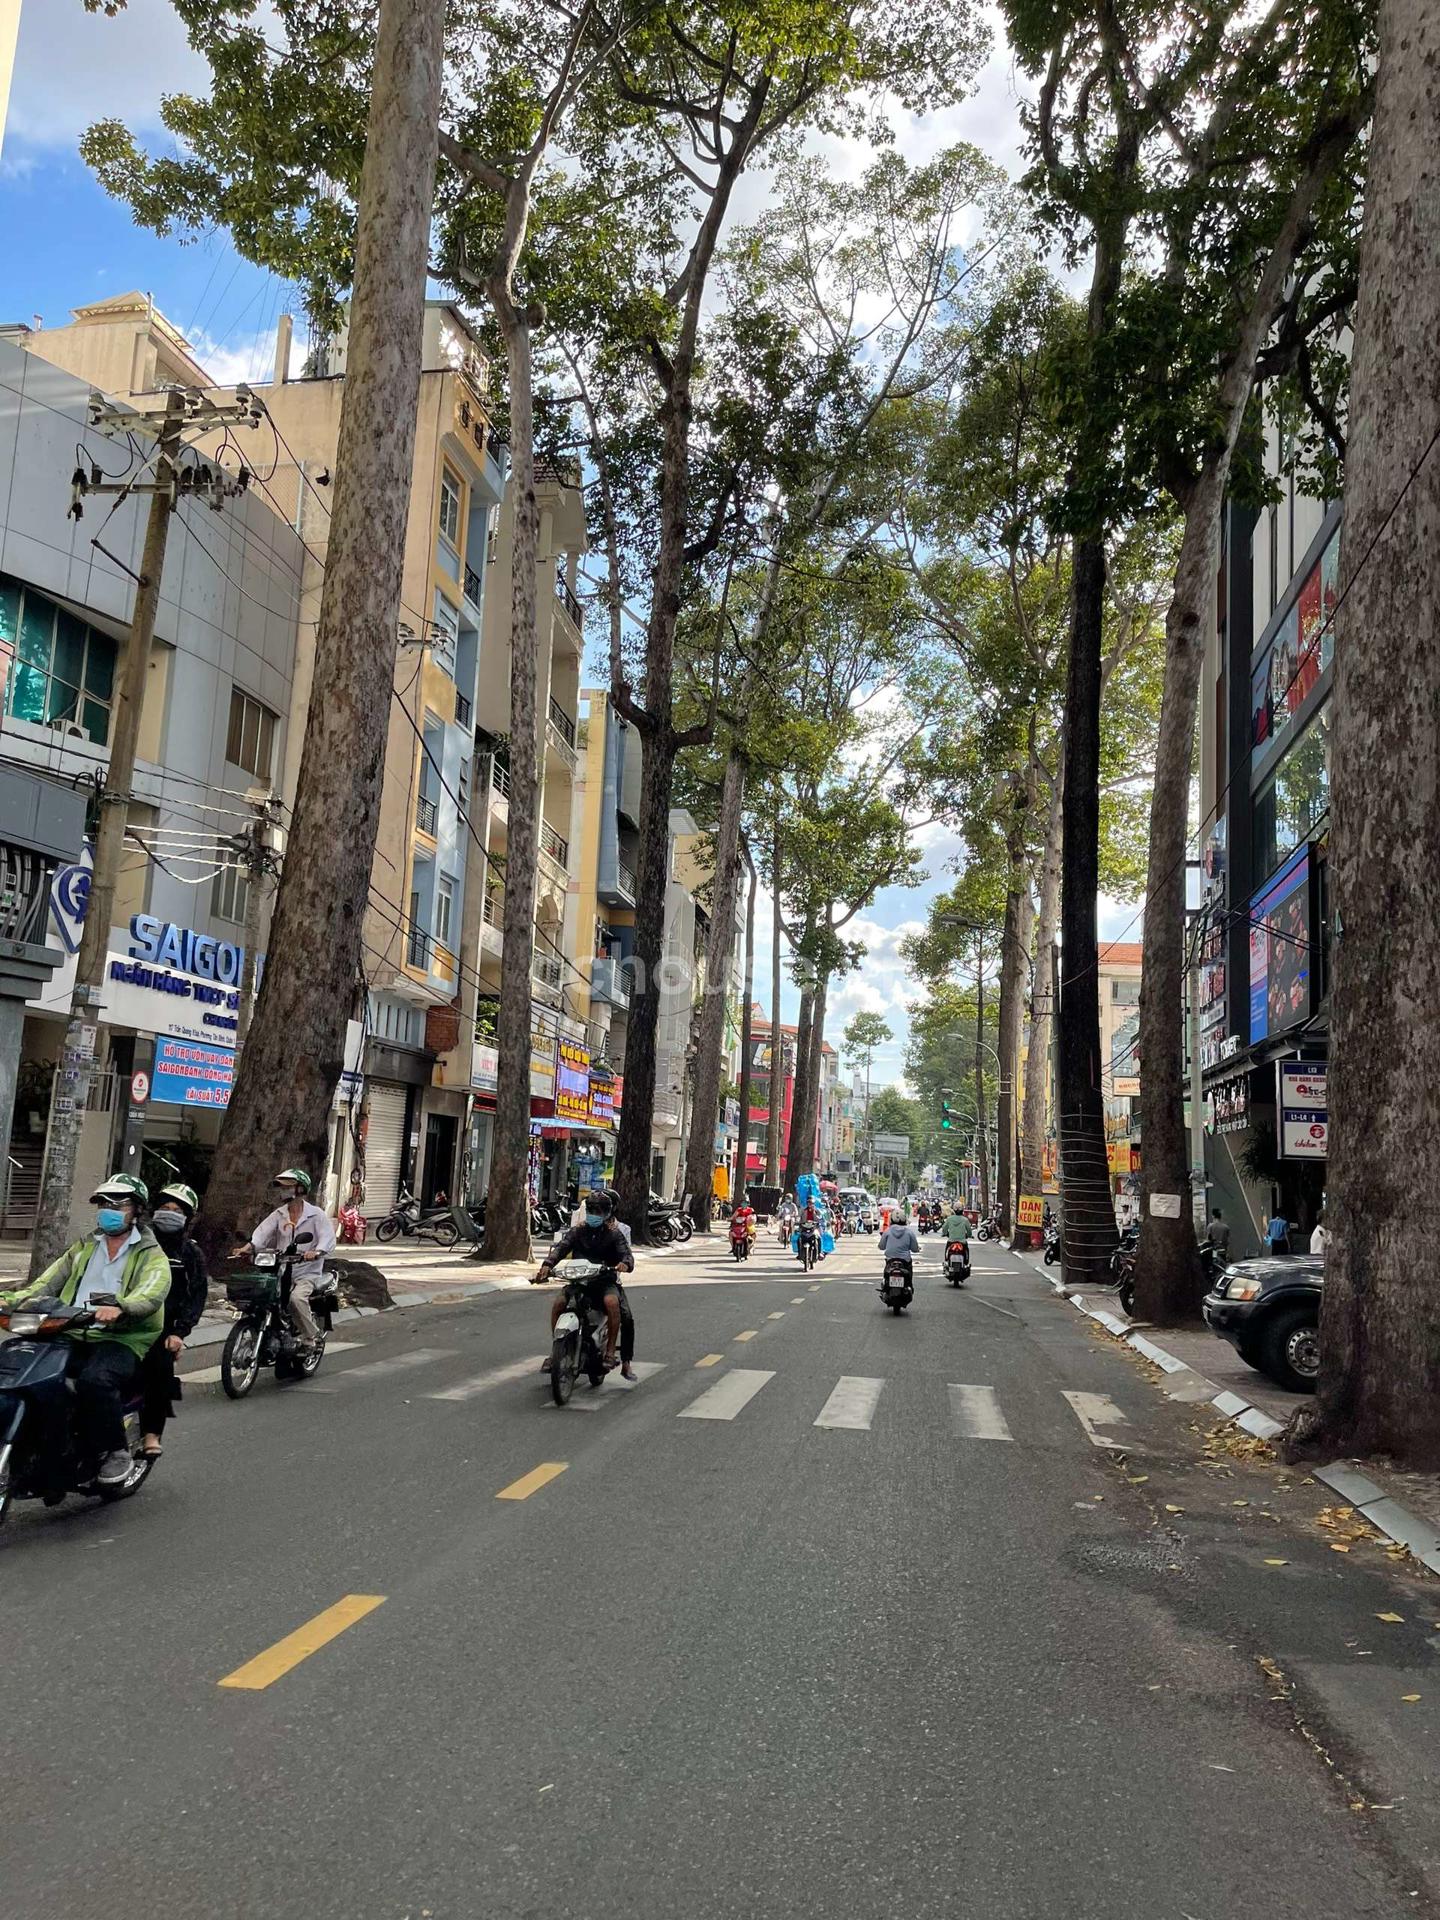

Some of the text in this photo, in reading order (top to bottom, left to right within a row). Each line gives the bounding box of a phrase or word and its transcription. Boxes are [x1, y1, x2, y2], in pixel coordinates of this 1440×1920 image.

[152, 970, 192, 997] HÀNG
[157, 1061, 204, 1079] SAIGONBANK
[1033, 1213, 1042, 1224] XE
